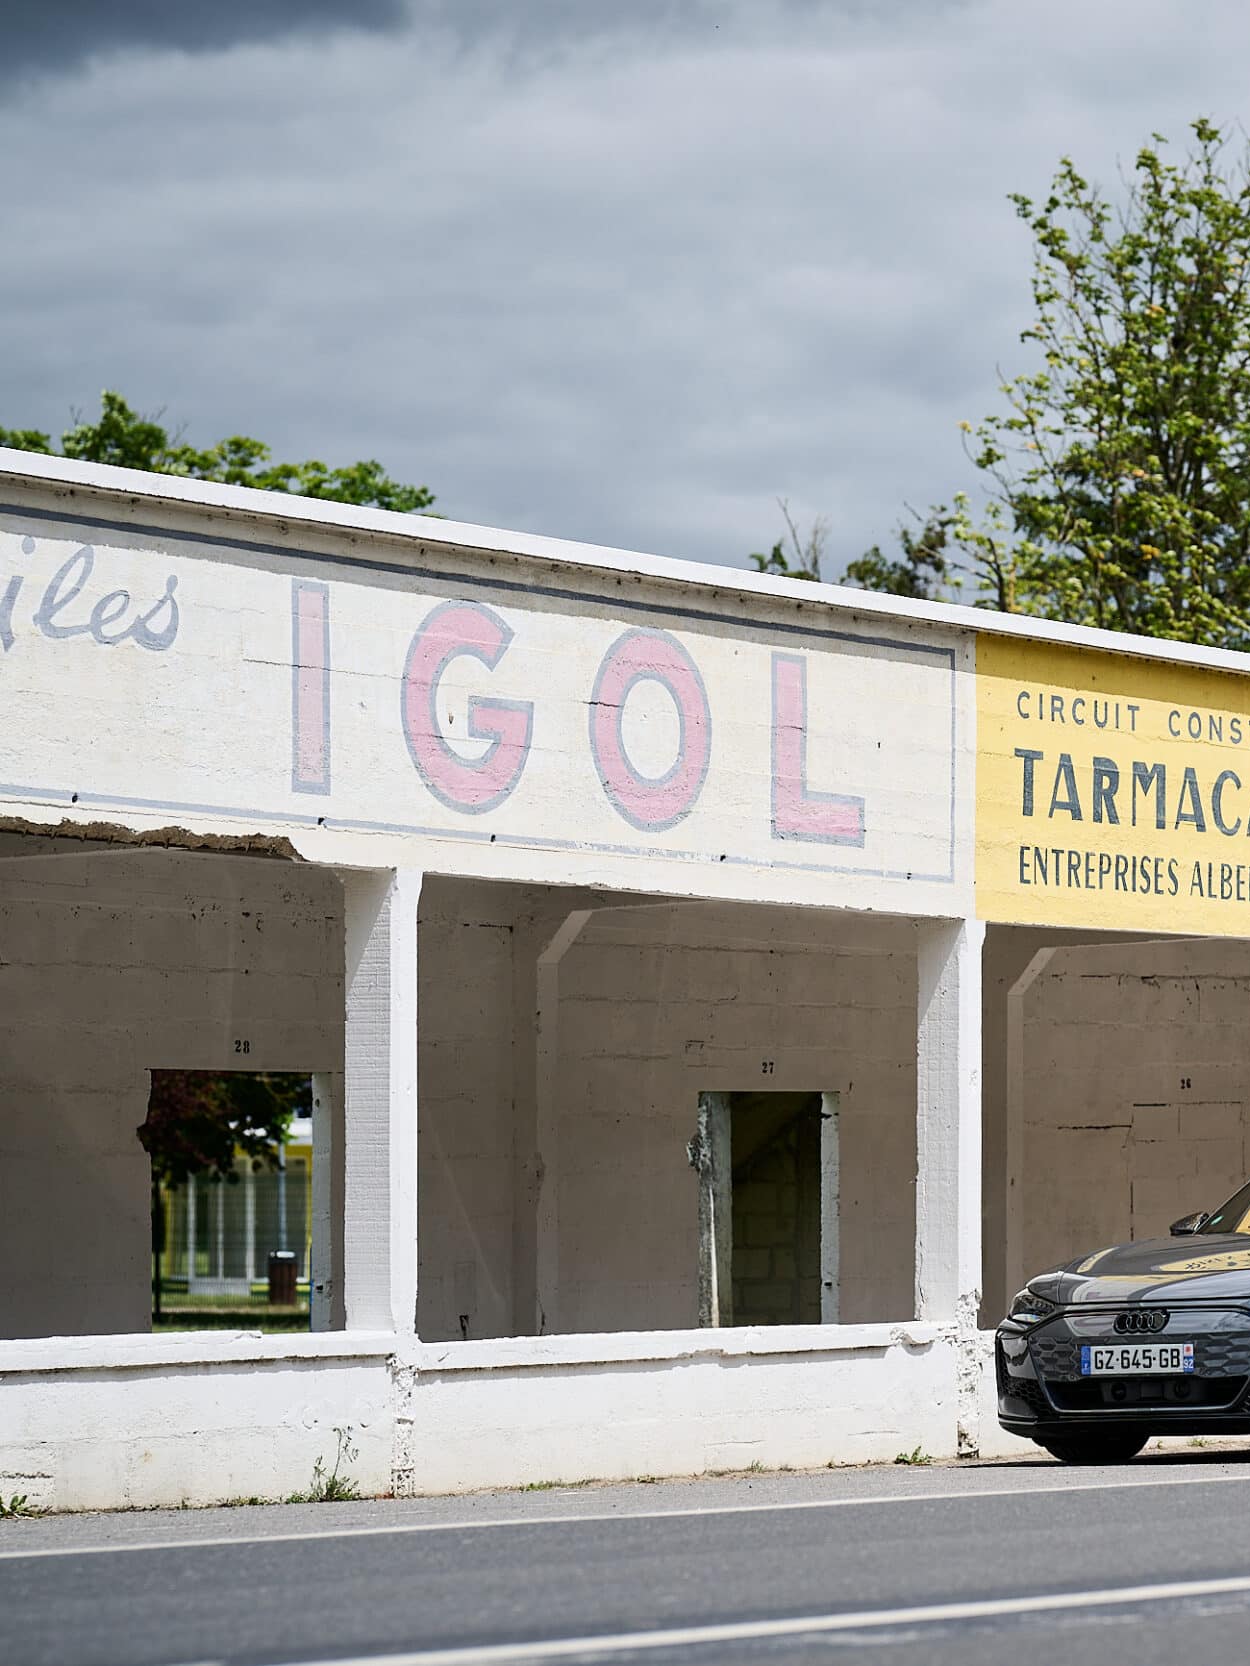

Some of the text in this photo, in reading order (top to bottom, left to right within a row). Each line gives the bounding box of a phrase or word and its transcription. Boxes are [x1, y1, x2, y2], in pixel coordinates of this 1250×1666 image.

[291, 577, 865, 848] IGOL
[1016, 690, 1140, 732] CIRCUIT
[1018, 845, 1179, 896] ENTREPRISES
[234, 1039, 250, 1054] 28
[761, 1061, 775, 1075] 27
[1183, 1358, 1194, 1369] 92
